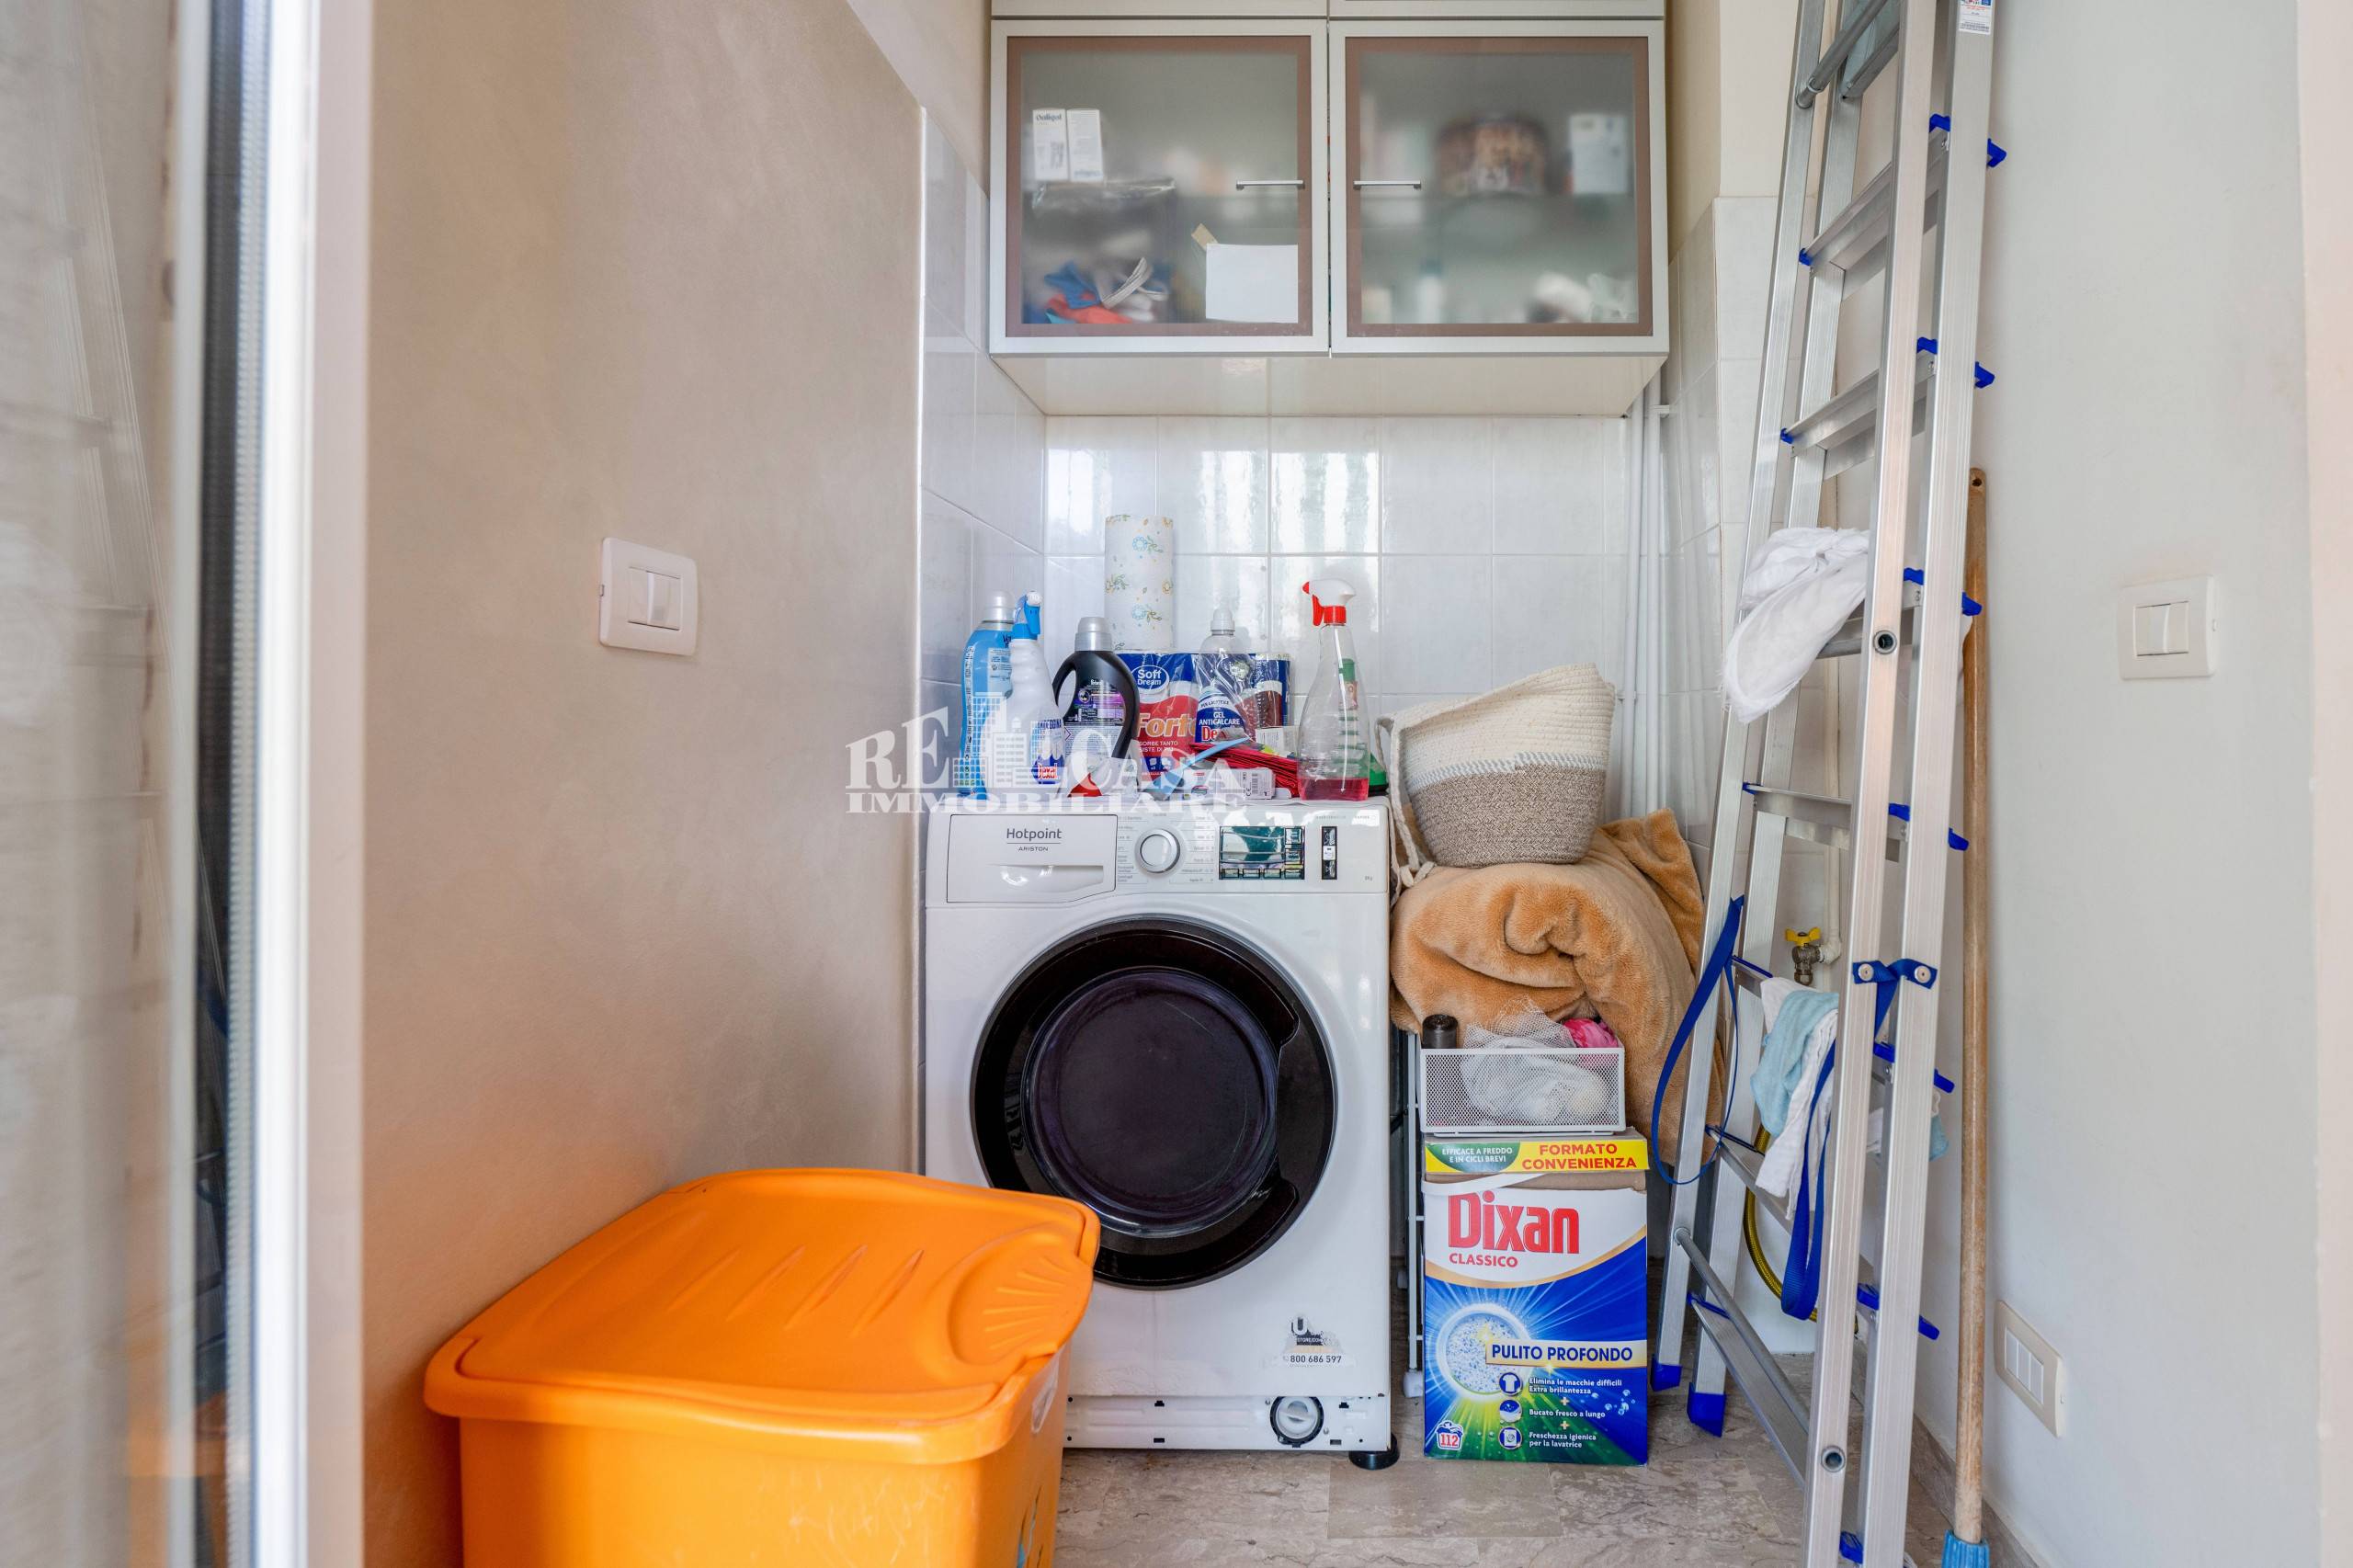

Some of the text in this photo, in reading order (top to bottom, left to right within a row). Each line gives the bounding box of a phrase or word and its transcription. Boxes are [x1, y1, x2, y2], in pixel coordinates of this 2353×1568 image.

[1137, 669, 1162, 679] Soft
[1006, 828, 1063, 842] Hotpoint
[1539, 1142, 1618, 1155] FORMATO
[1521, 1156, 1637, 1170] CONVENIENZA
[1448, 1190, 1580, 1255] Dixan
[1449, 1253, 1518, 1268] CLASSICO
[1492, 1344, 1633, 1361] PULITO PROFONDO
[1290, 1355, 1342, 1363] 800 686 597
[1565, 1379, 1595, 1387] macchie
[1550, 1386, 1591, 1394] brillantezza
[1555, 1409, 1578, 1417] fresco
[1586, 1409, 1606, 1419] lungo
[1440, 1434, 1459, 1446] 112
[1529, 1432, 1597, 1441] Freschezza igienica
